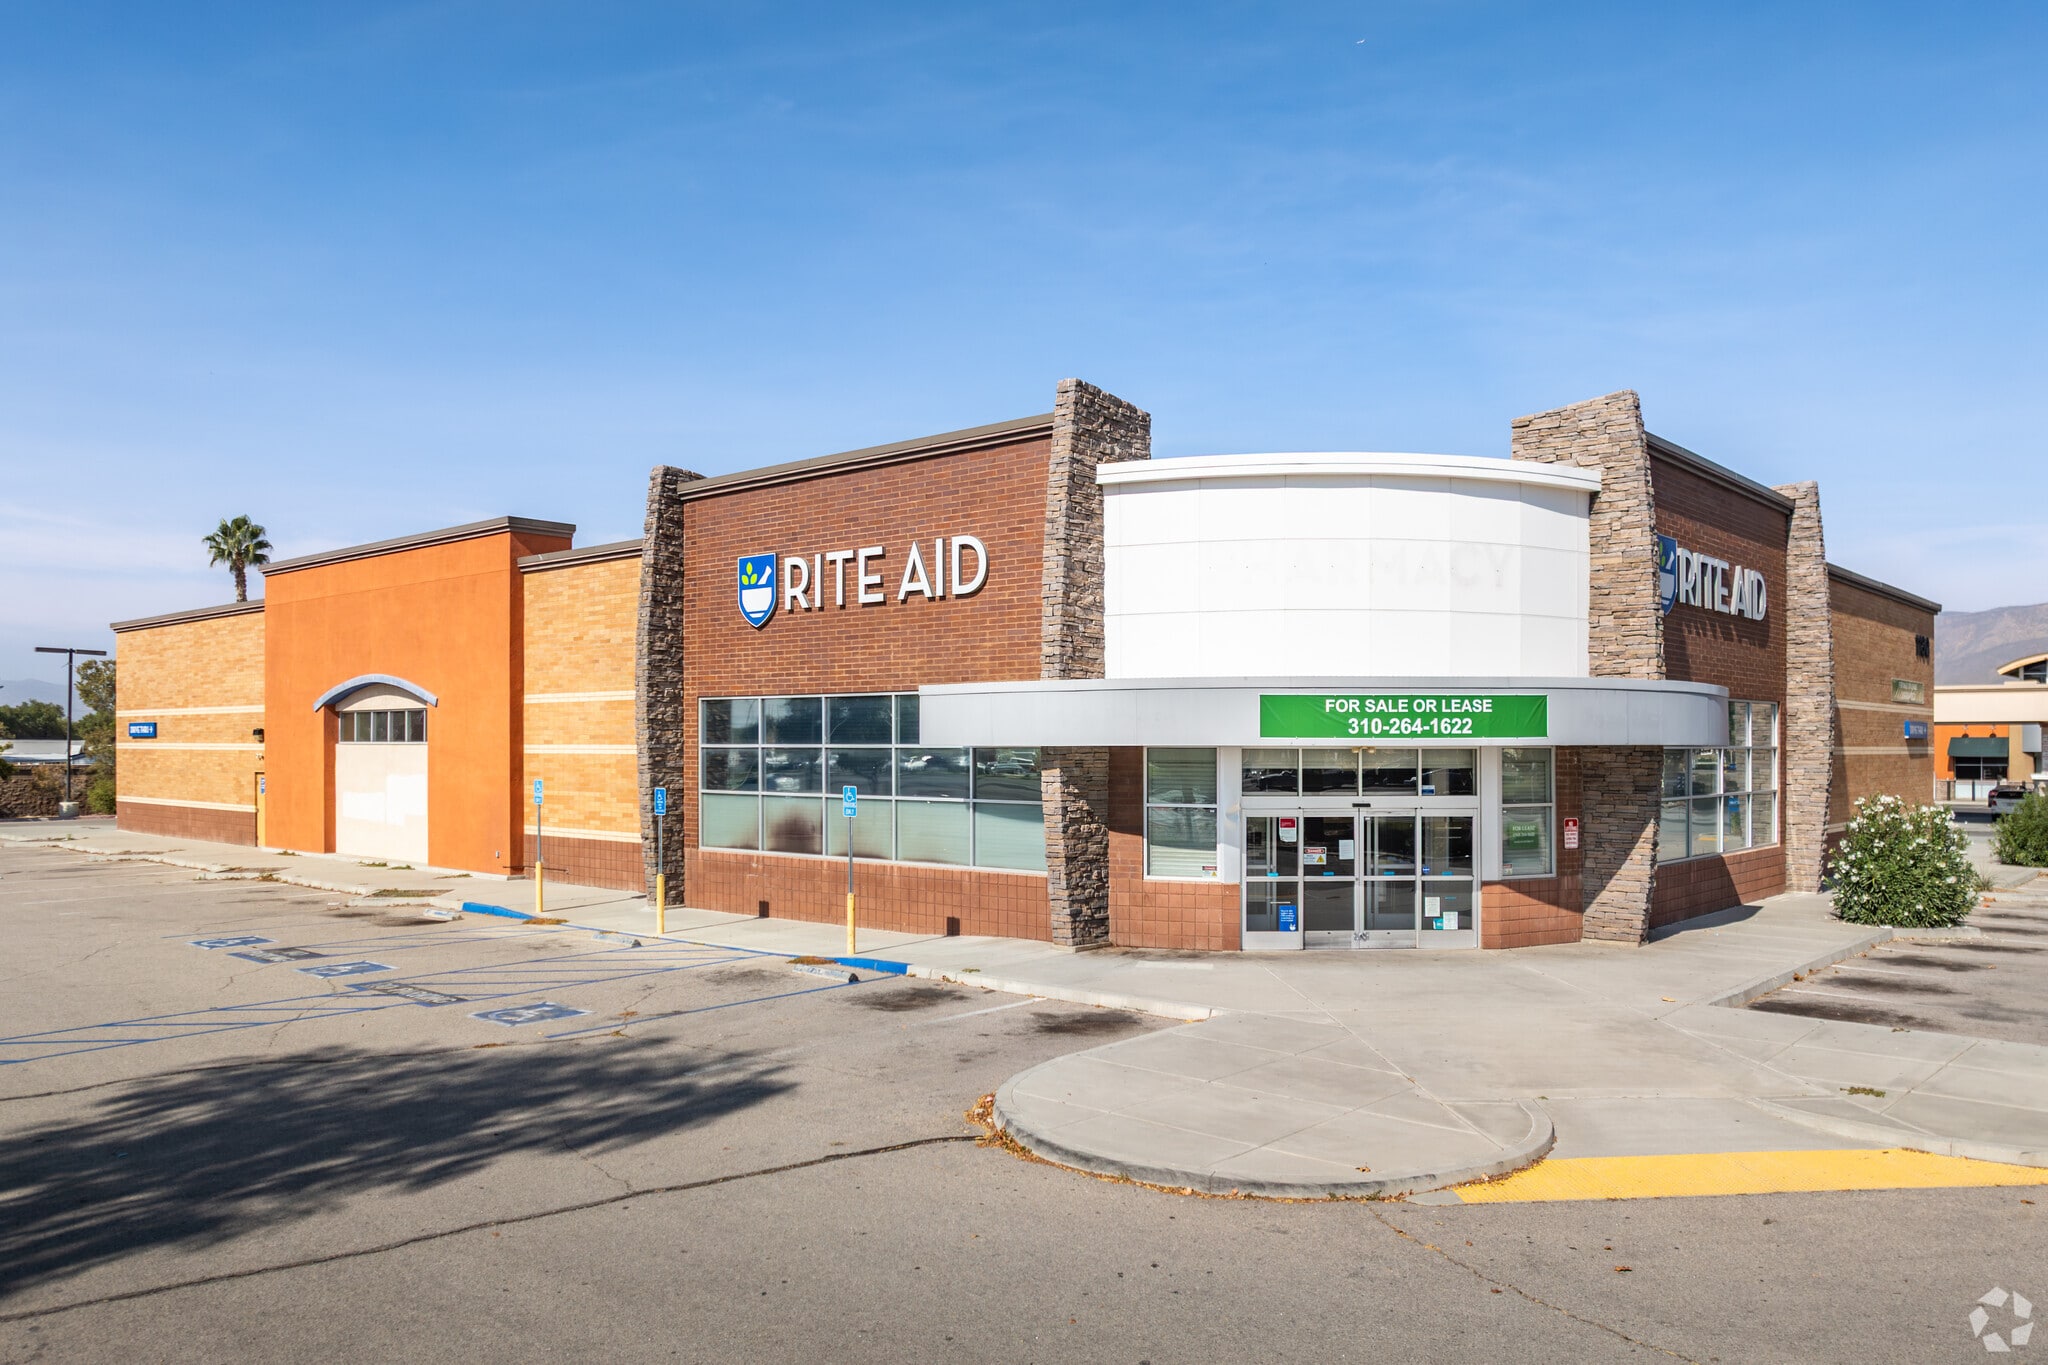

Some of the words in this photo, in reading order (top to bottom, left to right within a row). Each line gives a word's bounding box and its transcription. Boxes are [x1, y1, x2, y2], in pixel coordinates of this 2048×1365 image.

[784, 546, 886, 611] RITE
[897, 535, 989, 603] AID
[1677, 547, 1730, 614] RITE
[1730, 565, 1767, 621] AID
[1325, 699, 1360, 713] FOR
[1364, 699, 1409, 713] SALE
[1413, 699, 1438, 713] OR
[1441, 699, 1493, 713] LEASE
[1347, 717, 1473, 735] 310-264-1622
